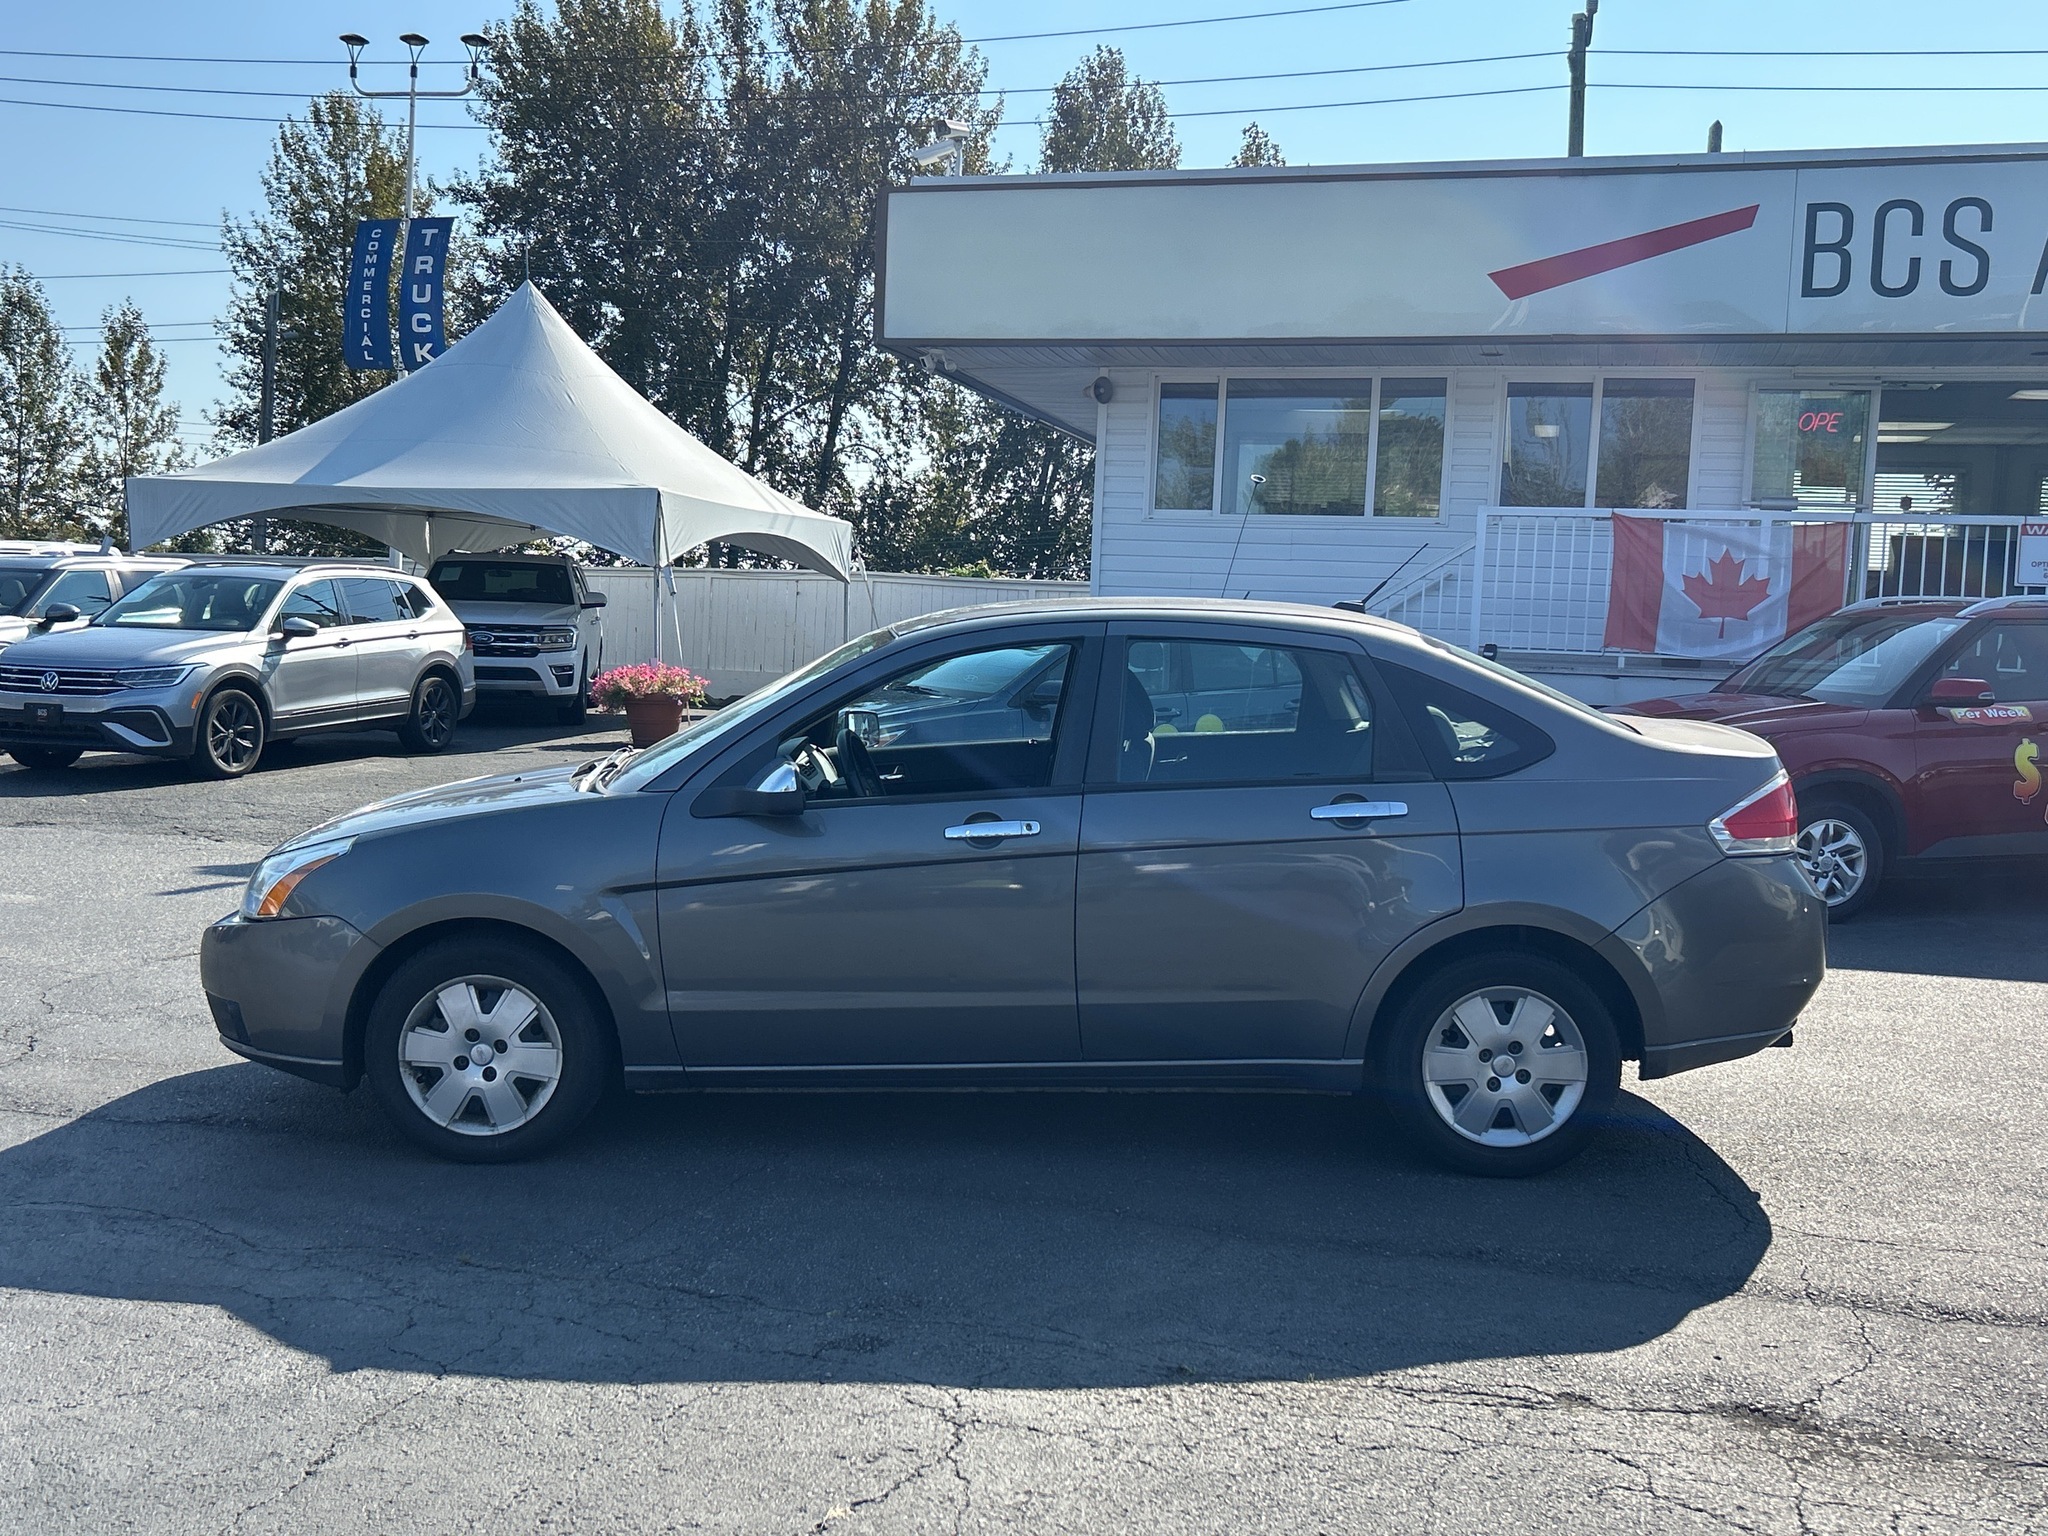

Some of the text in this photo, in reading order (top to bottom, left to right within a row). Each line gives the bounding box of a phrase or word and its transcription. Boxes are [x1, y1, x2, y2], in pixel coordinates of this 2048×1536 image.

[361, 229, 382, 361] COMMERCIAL
[412, 228, 438, 362] TRUCK
[1801, 197, 1994, 298] BCS
[1954, 707, 2027, 719] Per Week
[2013, 738, 2042, 805] $
